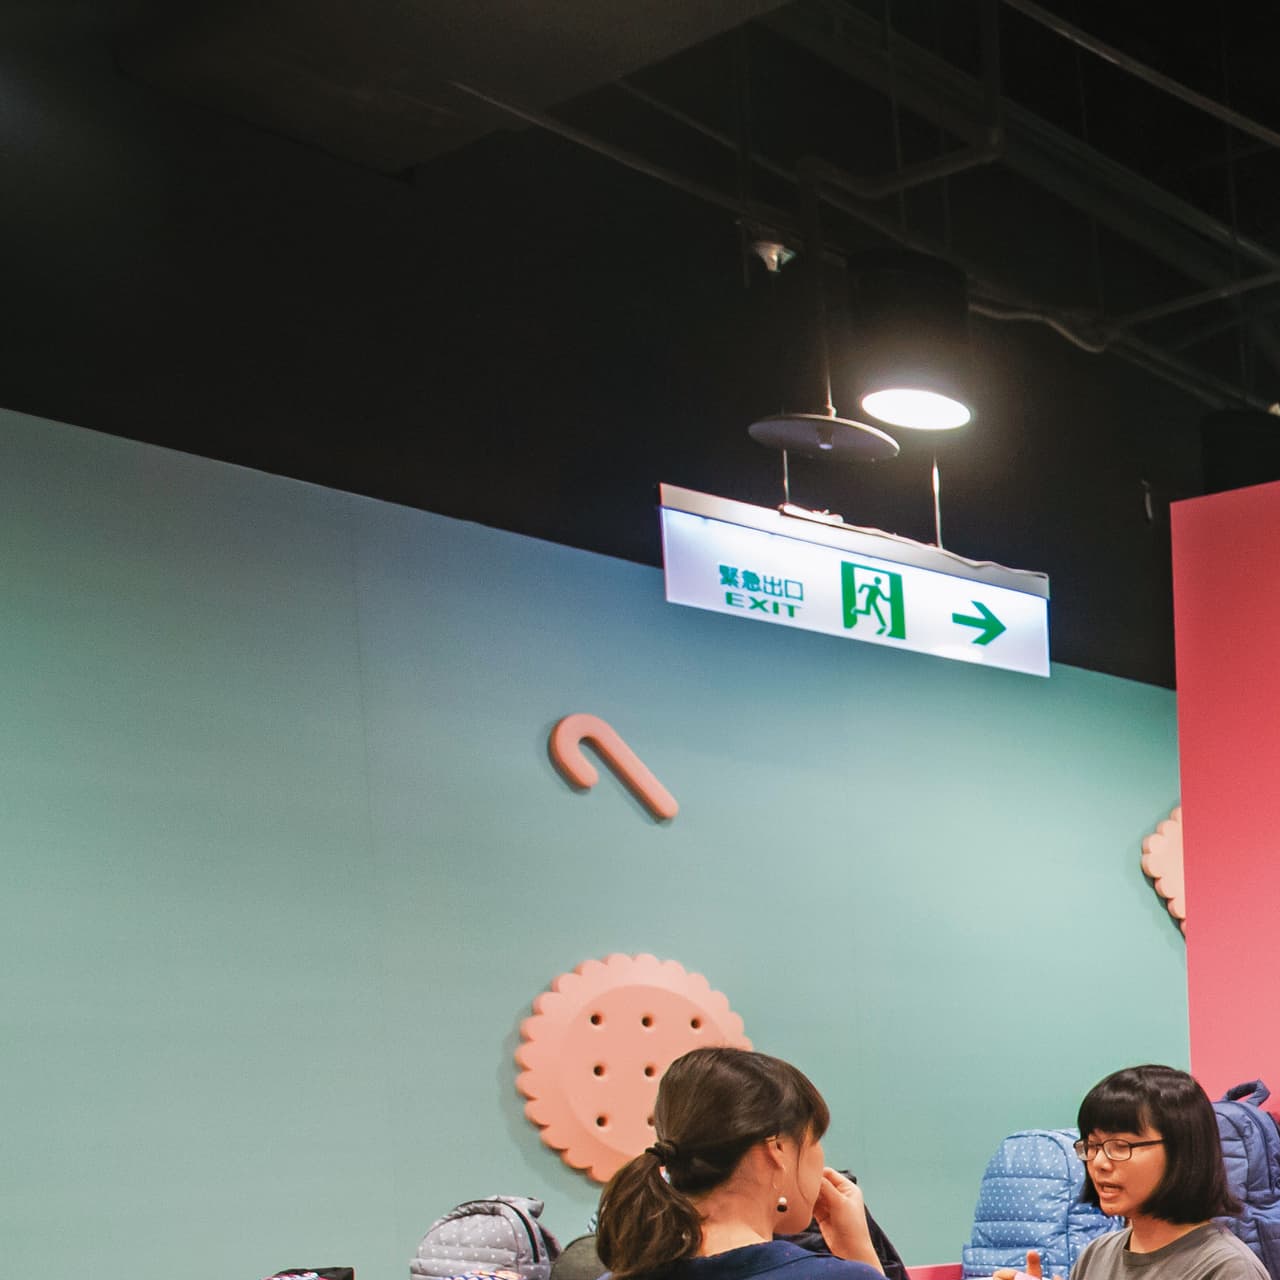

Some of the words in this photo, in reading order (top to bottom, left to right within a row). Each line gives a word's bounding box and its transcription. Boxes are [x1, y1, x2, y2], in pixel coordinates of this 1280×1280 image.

[719, 564, 804, 601] 緊急出口
[725, 591, 802, 618] EXIT
